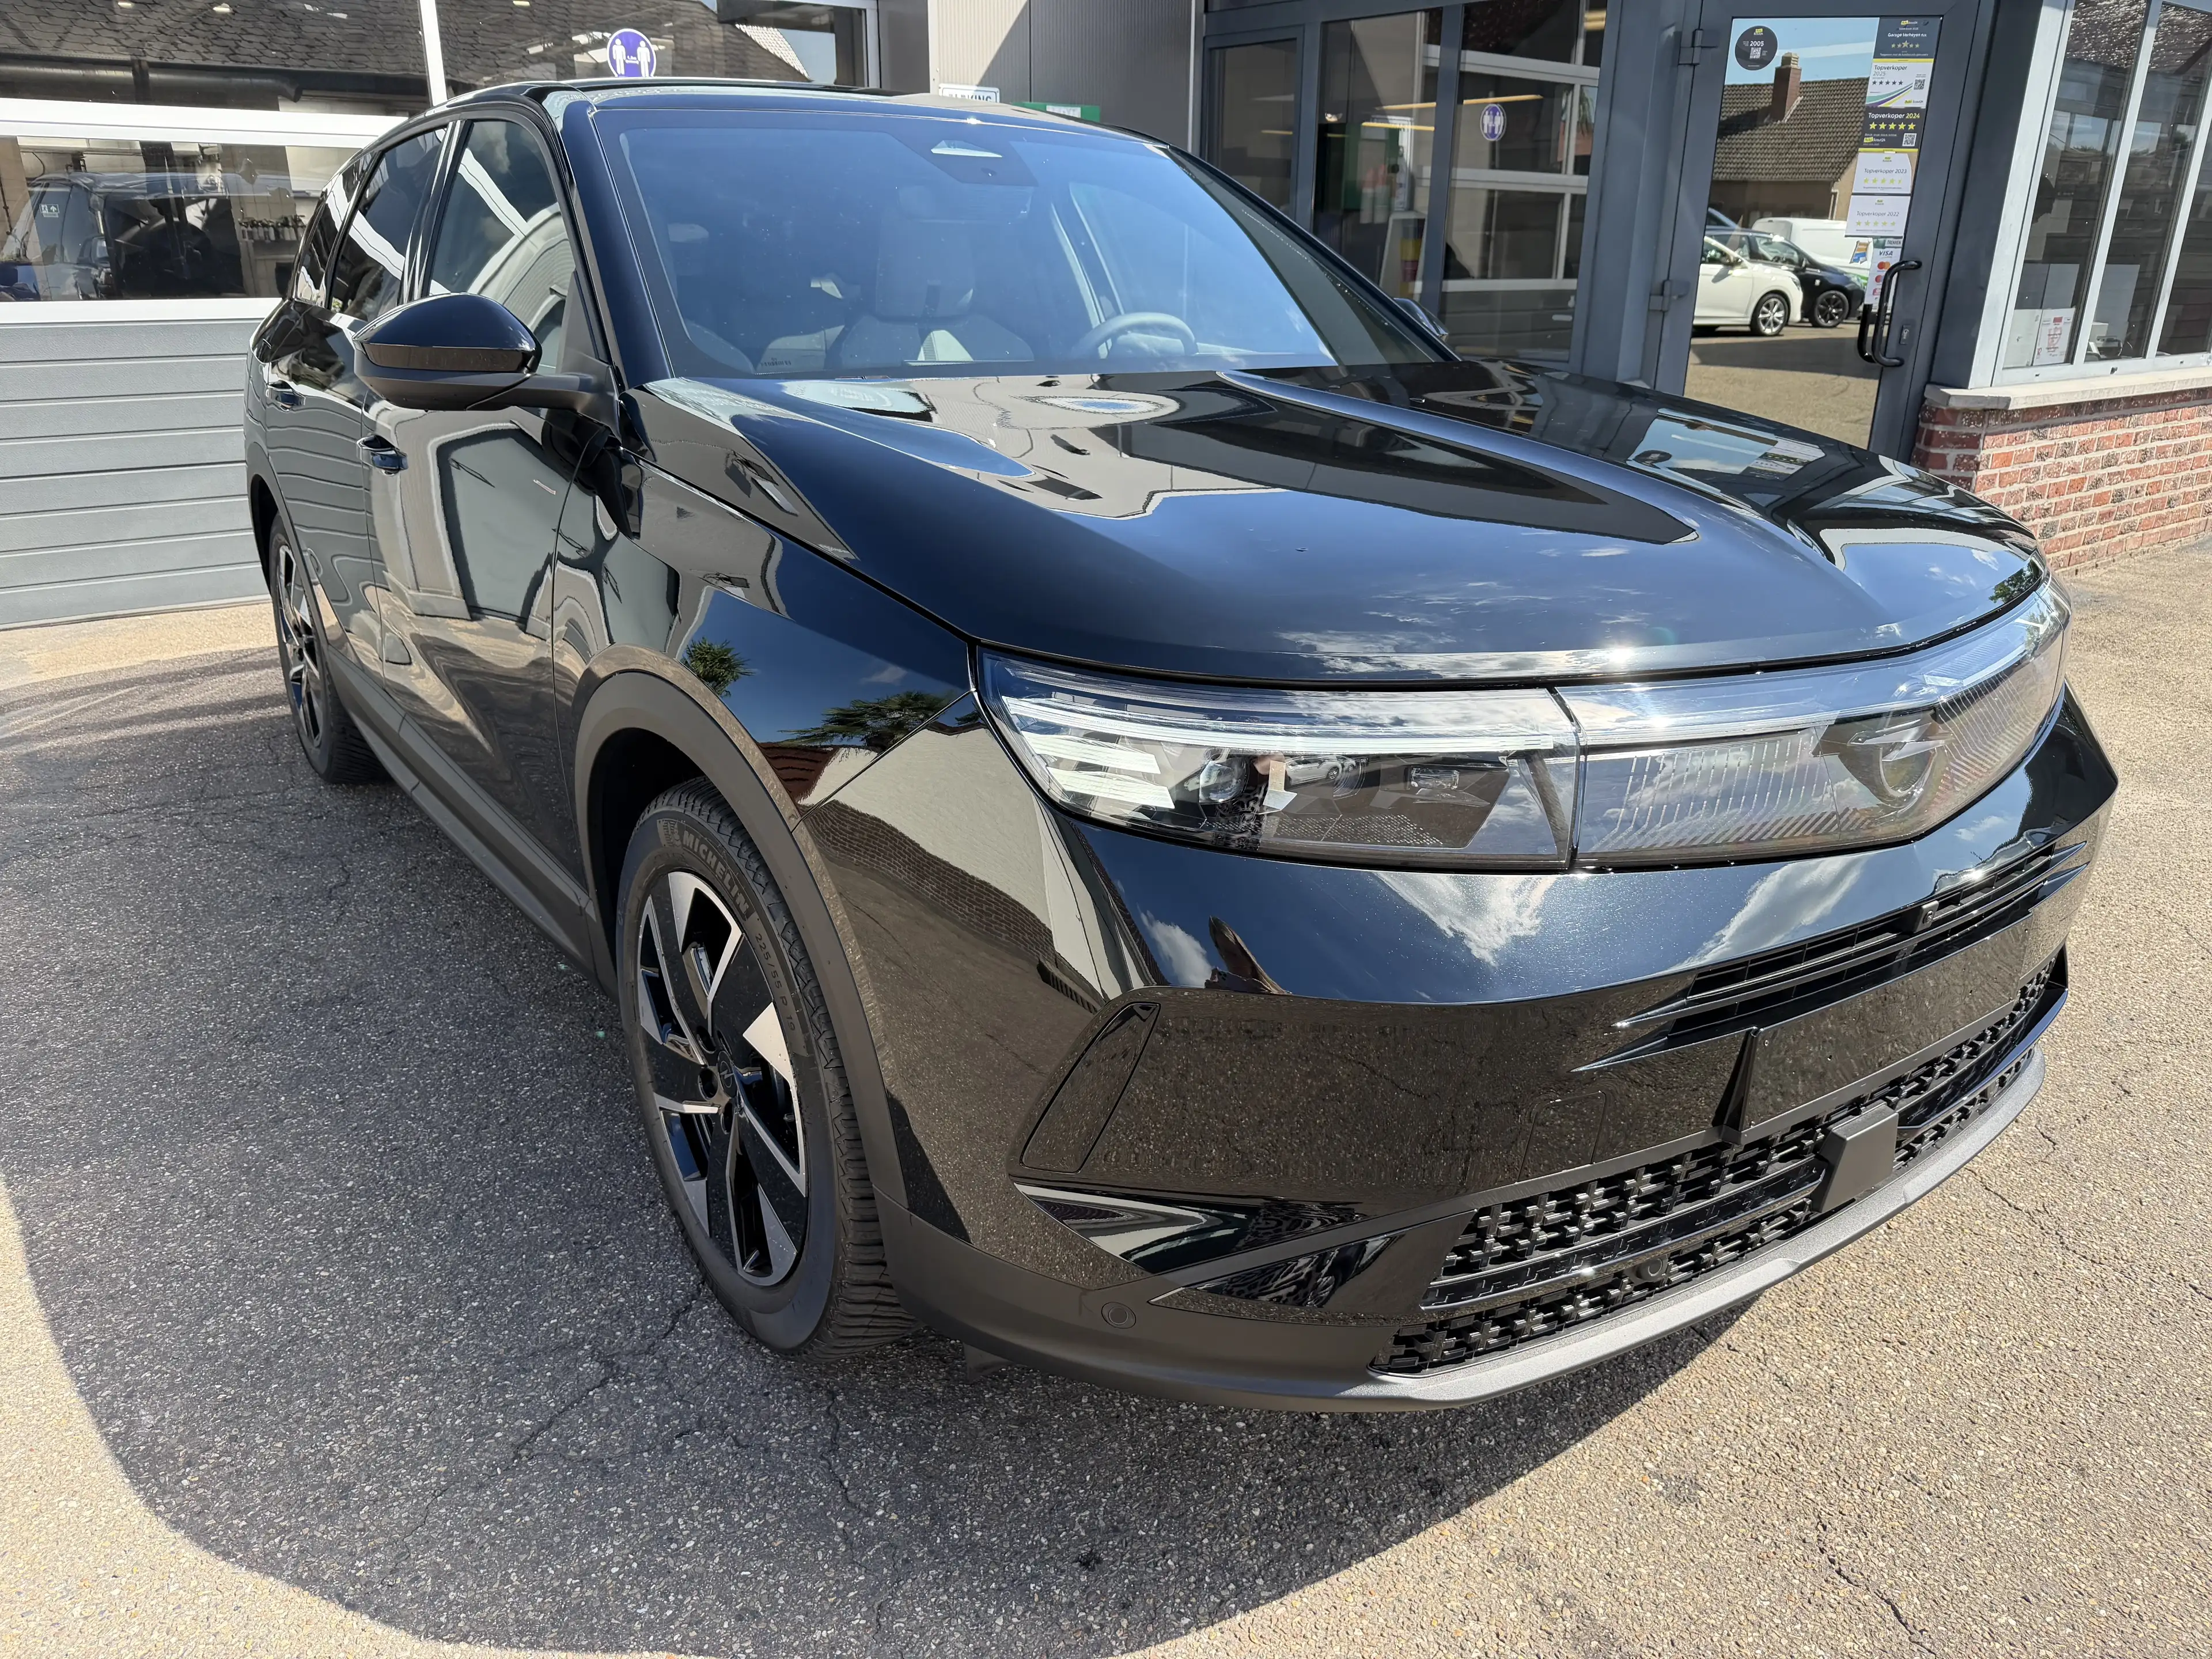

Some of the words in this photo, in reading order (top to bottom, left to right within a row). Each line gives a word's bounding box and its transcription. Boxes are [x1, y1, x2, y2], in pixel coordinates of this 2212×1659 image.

[683, 830, 749, 914] MICHELIN
[755, 933, 782, 988] 225/55
[786, 1014, 796, 1031] 19
